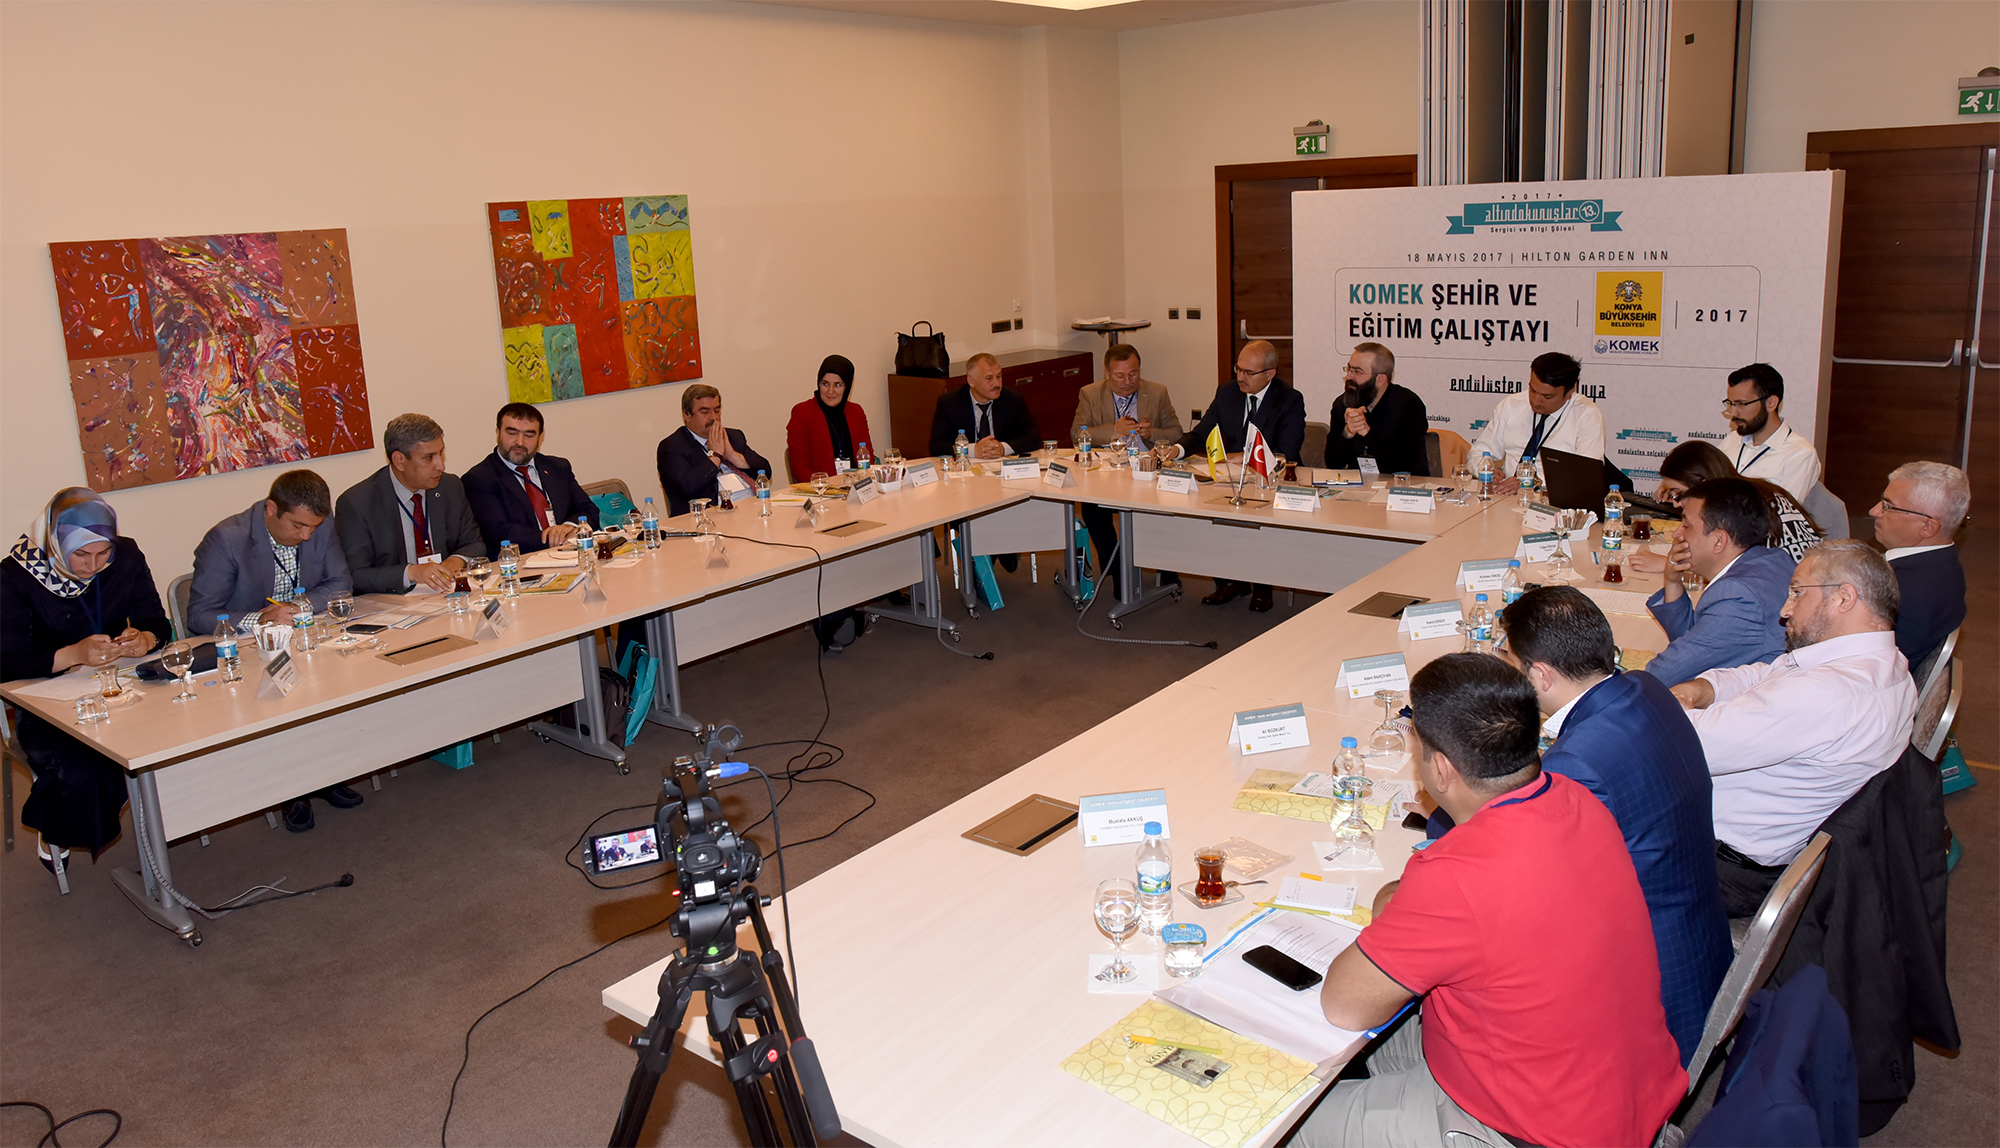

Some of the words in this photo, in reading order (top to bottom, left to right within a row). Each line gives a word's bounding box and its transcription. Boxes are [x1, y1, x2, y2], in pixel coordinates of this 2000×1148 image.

[1512, 193, 1551, 201] 2017
[1582, 204, 1597, 218] 13.
[1490, 226, 1516, 234] Sergisi
[1530, 226, 1548, 234] Bilgi
[1407, 253, 1421, 263] 18
[1427, 253, 1466, 262] MAYIS
[1473, 253, 1503, 262] 2017
[1521, 252, 1571, 262] HILTON
[1579, 251, 1635, 261] GARDEN
[1643, 250, 1669, 261] INN
[1349, 283, 1424, 305] KOMEK
[1431, 278, 1500, 311] ŞEHİR
[1508, 283, 1537, 306] VE
[1614, 303, 1643, 311] KONYA
[1599, 310, 1657, 323] BÜYÜKŞEHİR
[1695, 309, 1748, 323] 2017
[1349, 311, 1422, 339] EĞİTİM
[1430, 318, 1549, 347] ÇALIŞTAYI
[1609, 340, 1660, 351] KOMEK
[1145, 1045, 1175, 1066] KONY
